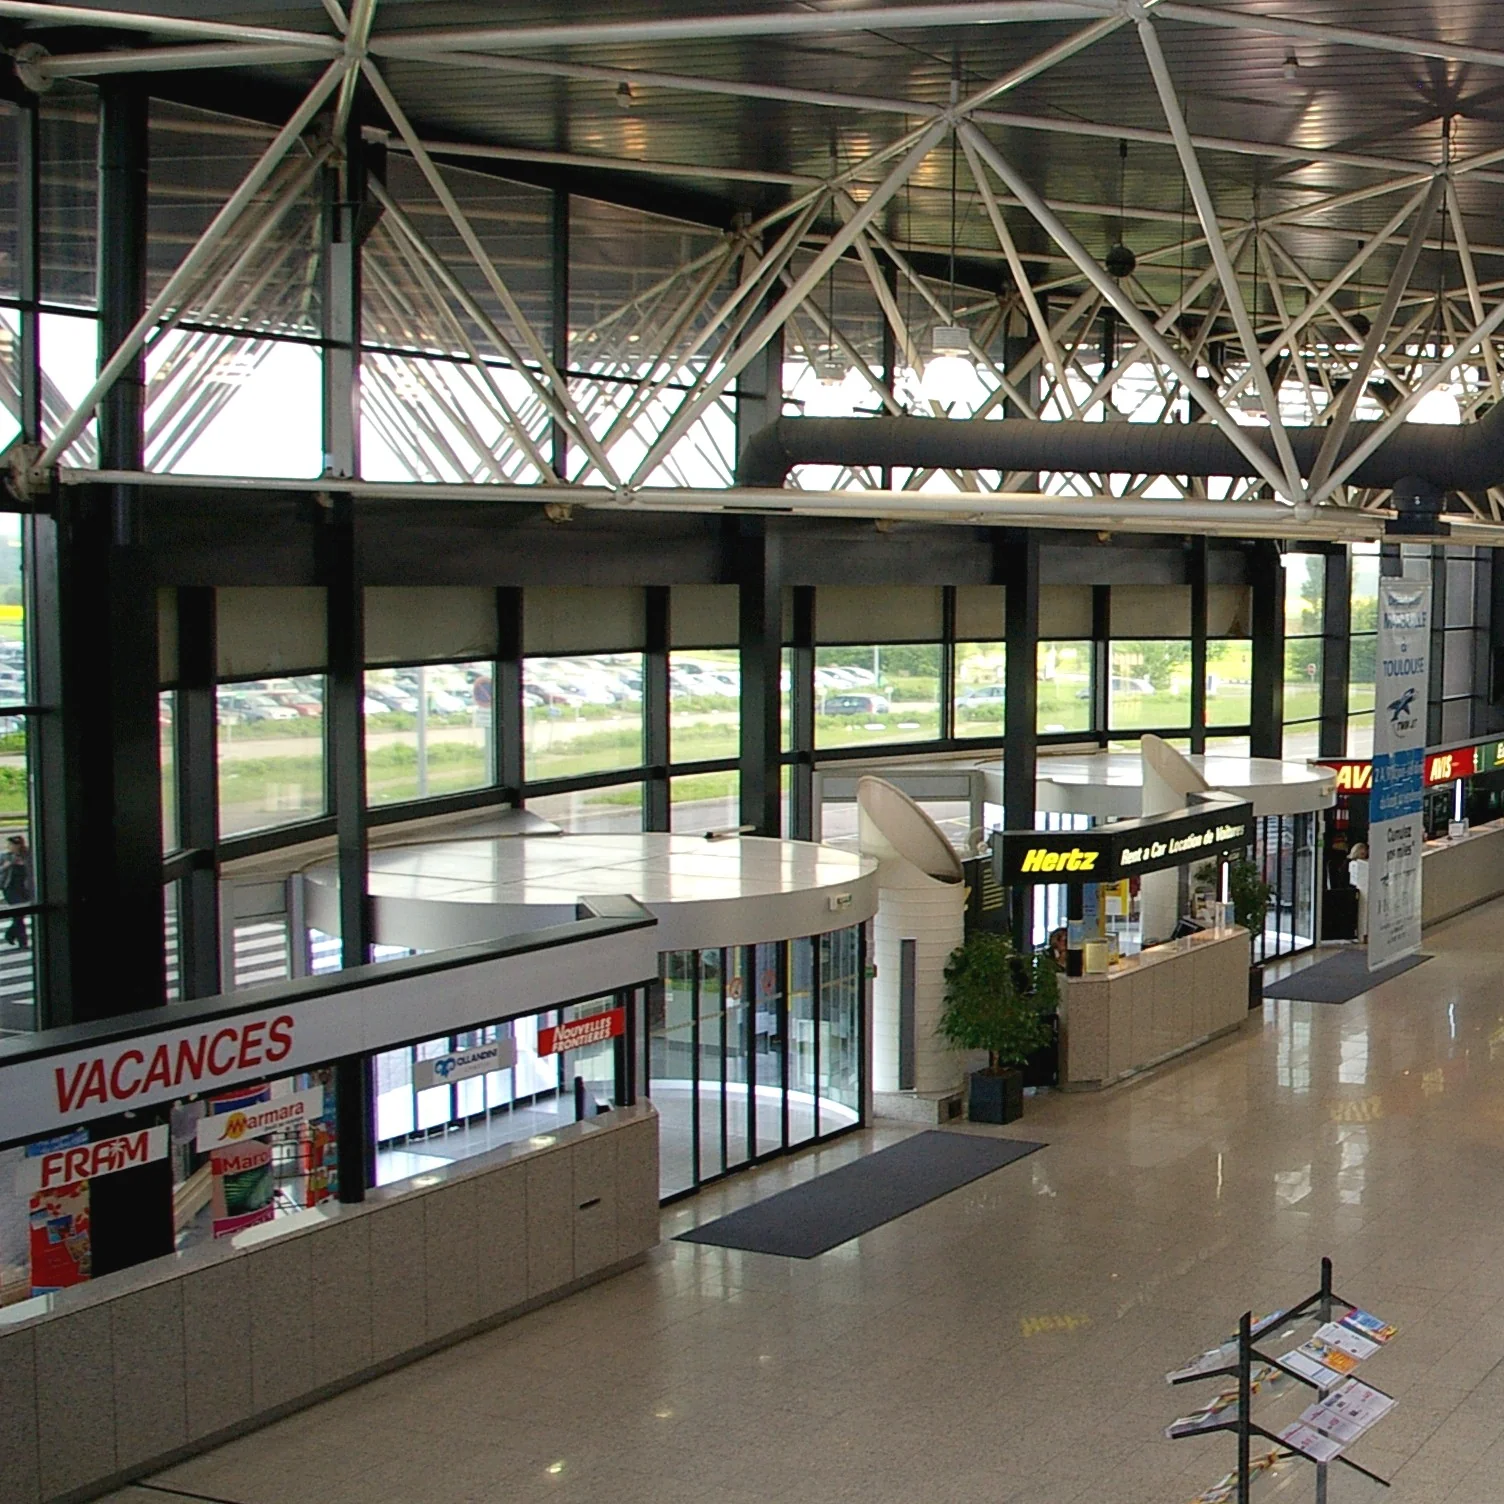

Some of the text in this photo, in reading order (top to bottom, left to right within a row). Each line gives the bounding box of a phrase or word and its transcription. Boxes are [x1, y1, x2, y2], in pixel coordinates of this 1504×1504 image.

[1383, 657, 1425, 677] TOULOUSE
[1430, 755, 1452, 781] AVIS
[1021, 848, 1099, 872] Hertz
[1120, 825, 1245, 866] Rent a Car Location de Voitures
[55, 1015, 294, 1114] VACANCES
[218, 1100, 304, 1141] Marmara
[41, 1130, 149, 1188] FRAM
